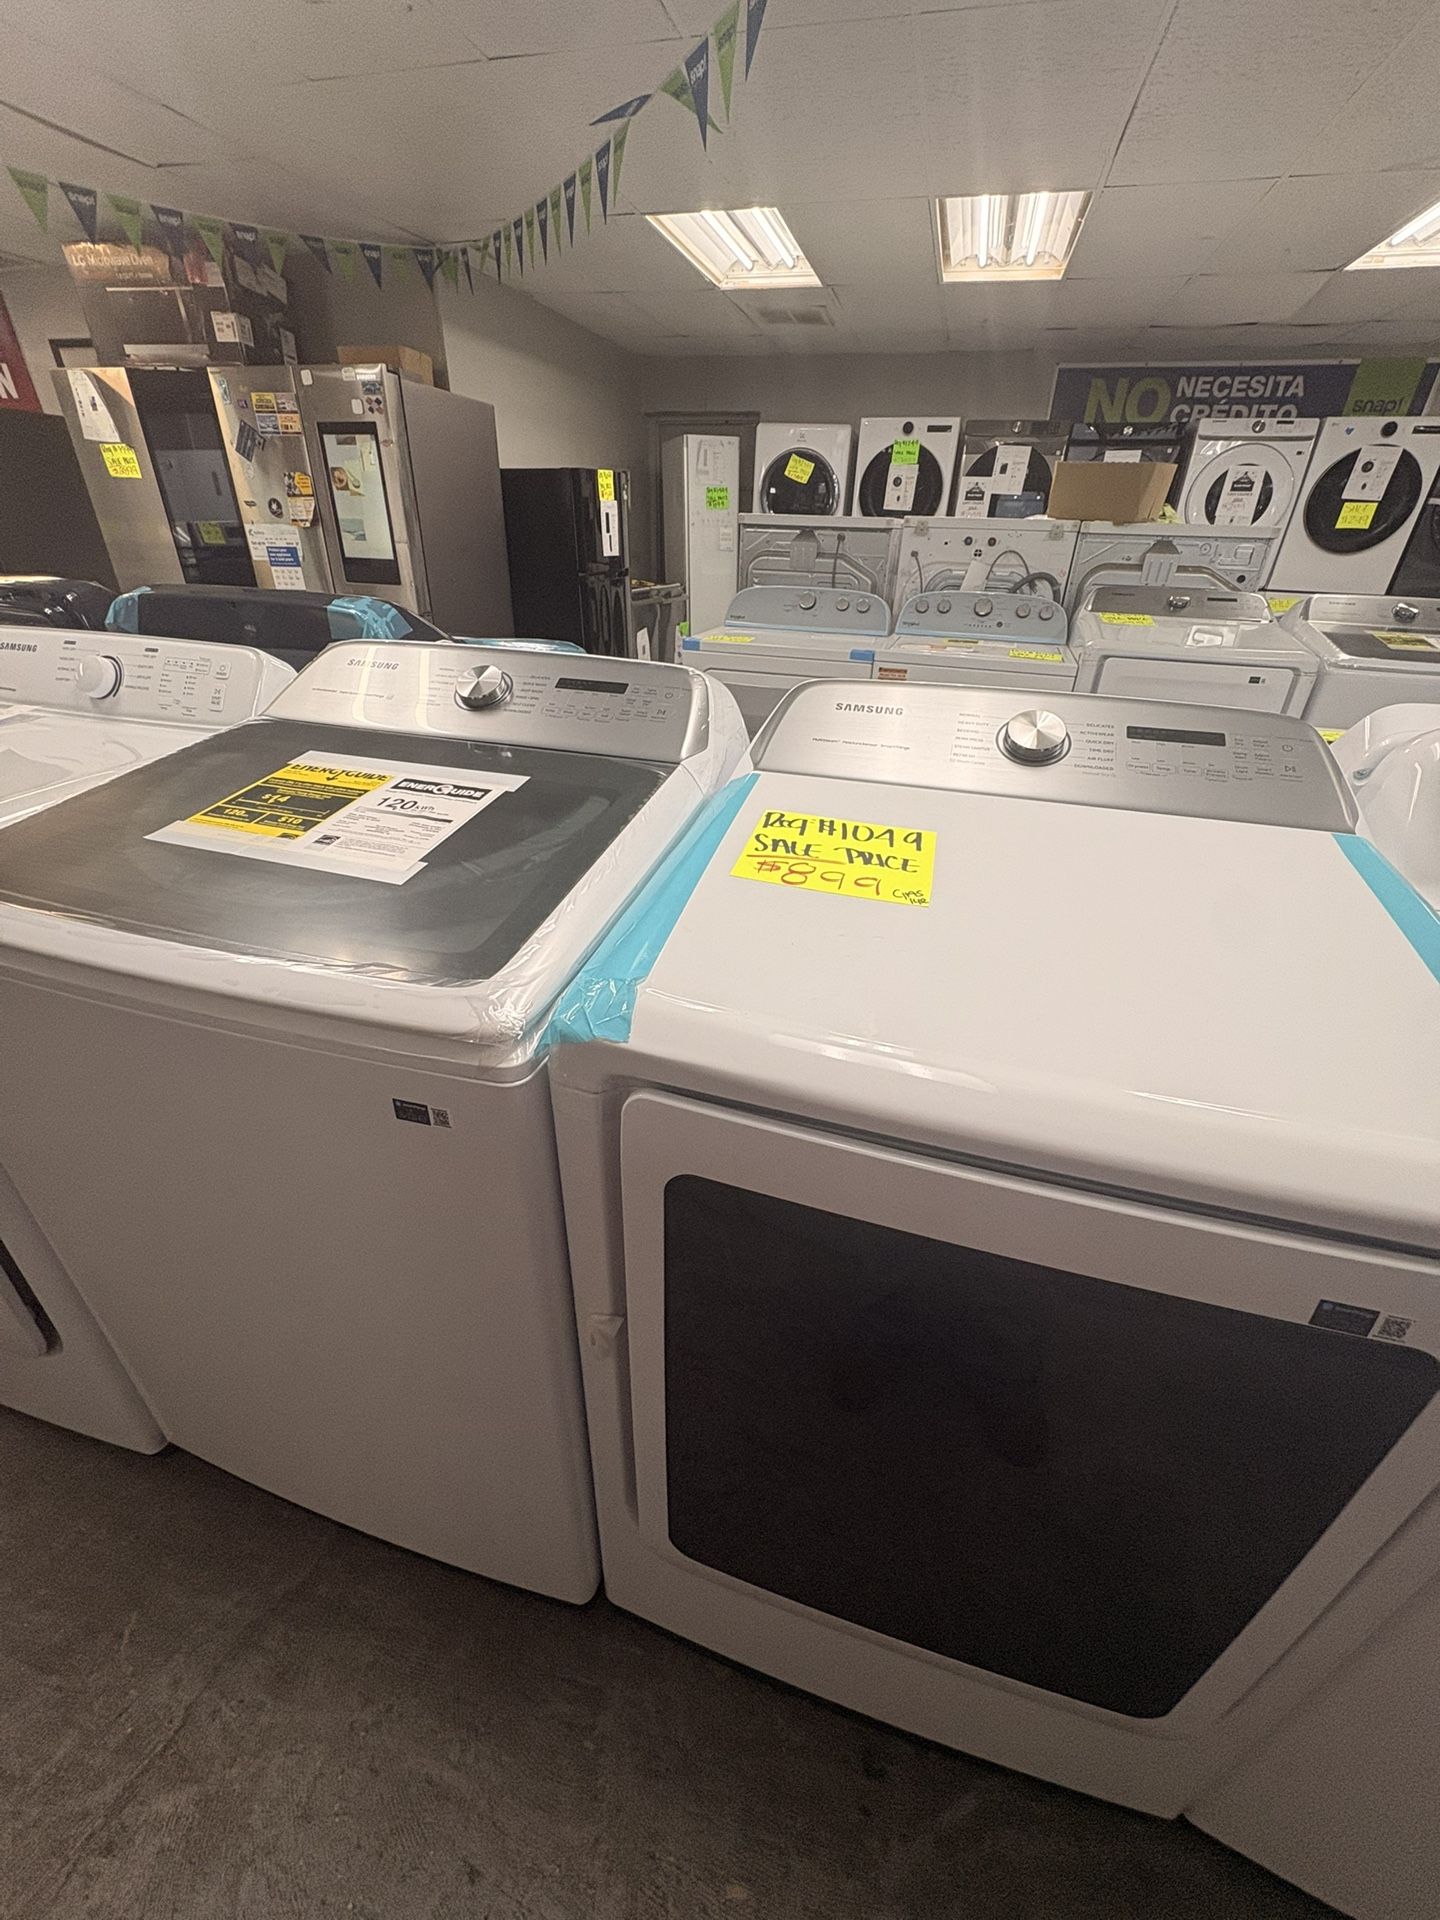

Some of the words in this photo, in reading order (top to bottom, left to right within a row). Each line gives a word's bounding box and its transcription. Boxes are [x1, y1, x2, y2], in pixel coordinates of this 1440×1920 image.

[1176, 375, 1304, 398] NECESITA
[1084, 376, 1171, 423] NO
[1169, 399, 1298, 421] CRÉDITO
[0, 642, 38, 653] SAMSUNG
[835, 702, 904, 716] SAMSUNG
[223, 808, 246, 816] 120
[377, 796, 418, 811] 120
[754, 833, 823, 859] SALE
[833, 846, 921, 873] PRICE
[753, 859, 881, 896] $899
